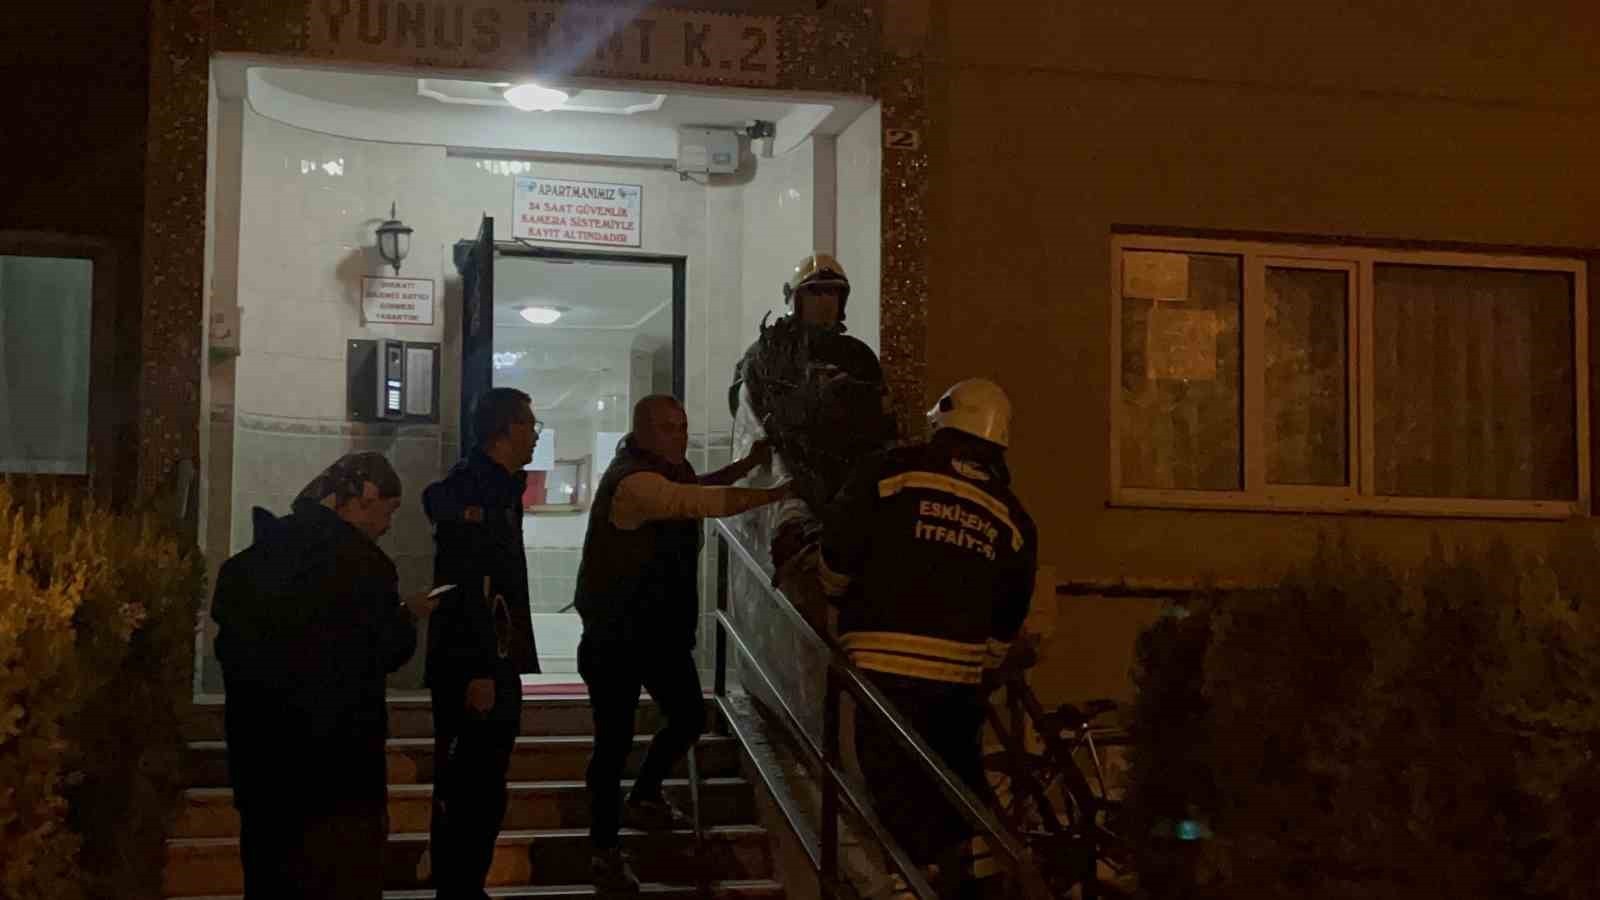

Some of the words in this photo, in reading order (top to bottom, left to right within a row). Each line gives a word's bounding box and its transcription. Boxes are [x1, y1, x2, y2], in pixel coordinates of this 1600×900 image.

[319, 0, 500, 52] YUNUS
[889, 130, 913, 147] 2
[538, 184, 616, 200] APARTMANIMIZ
[544, 202, 573, 212] SAAT
[521, 214, 566, 226] KAMERA
